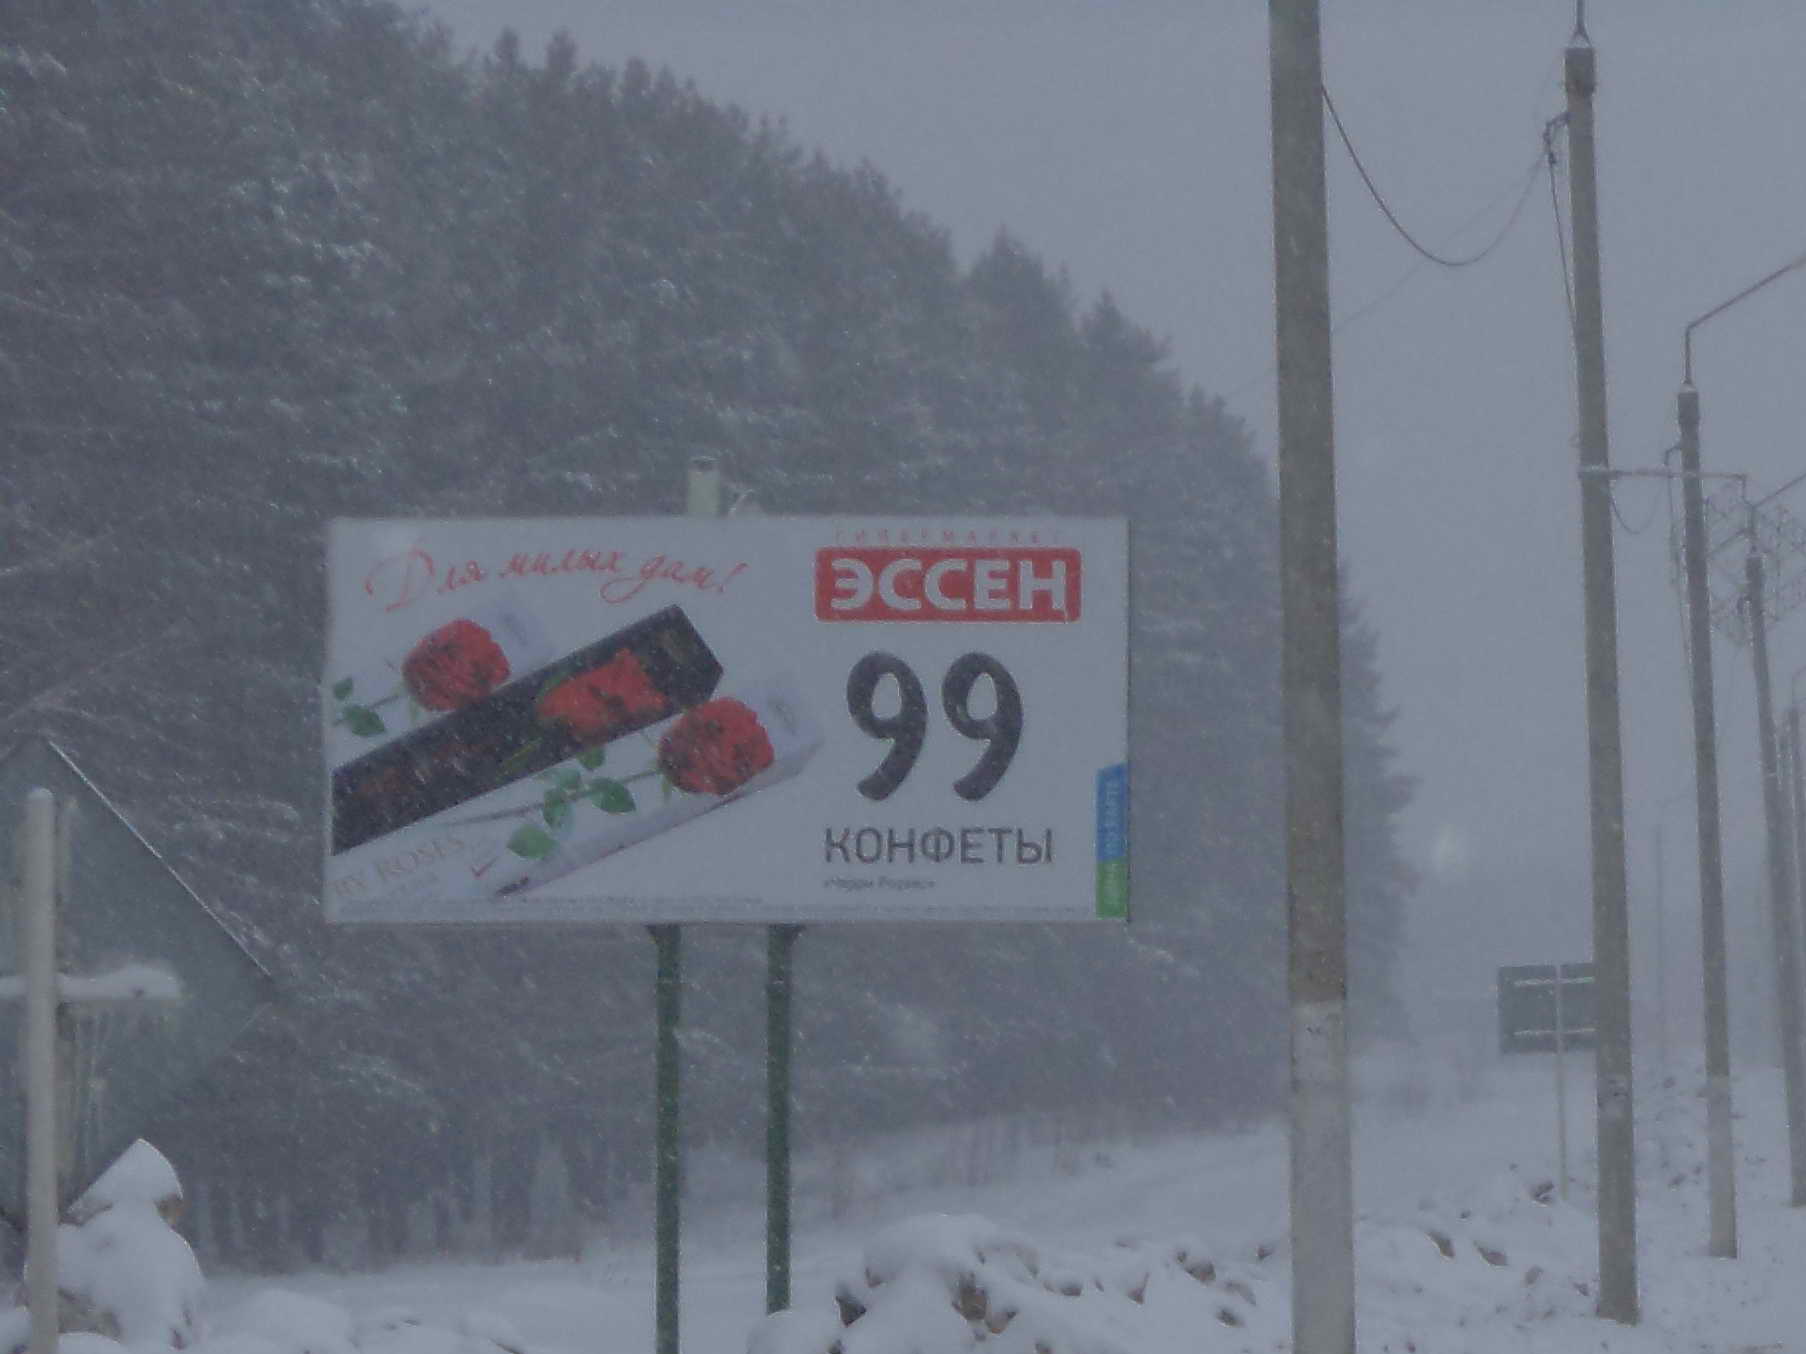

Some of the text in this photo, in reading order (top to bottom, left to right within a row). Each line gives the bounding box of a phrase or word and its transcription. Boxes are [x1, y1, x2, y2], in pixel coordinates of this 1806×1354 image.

[365, 538, 487, 613] Для
[498, 548, 623, 580] милых
[830, 557, 1068, 611] ЭССЕН
[845, 650, 1025, 802] 99
[823, 827, 1053, 865] КОНФЕТЫ
